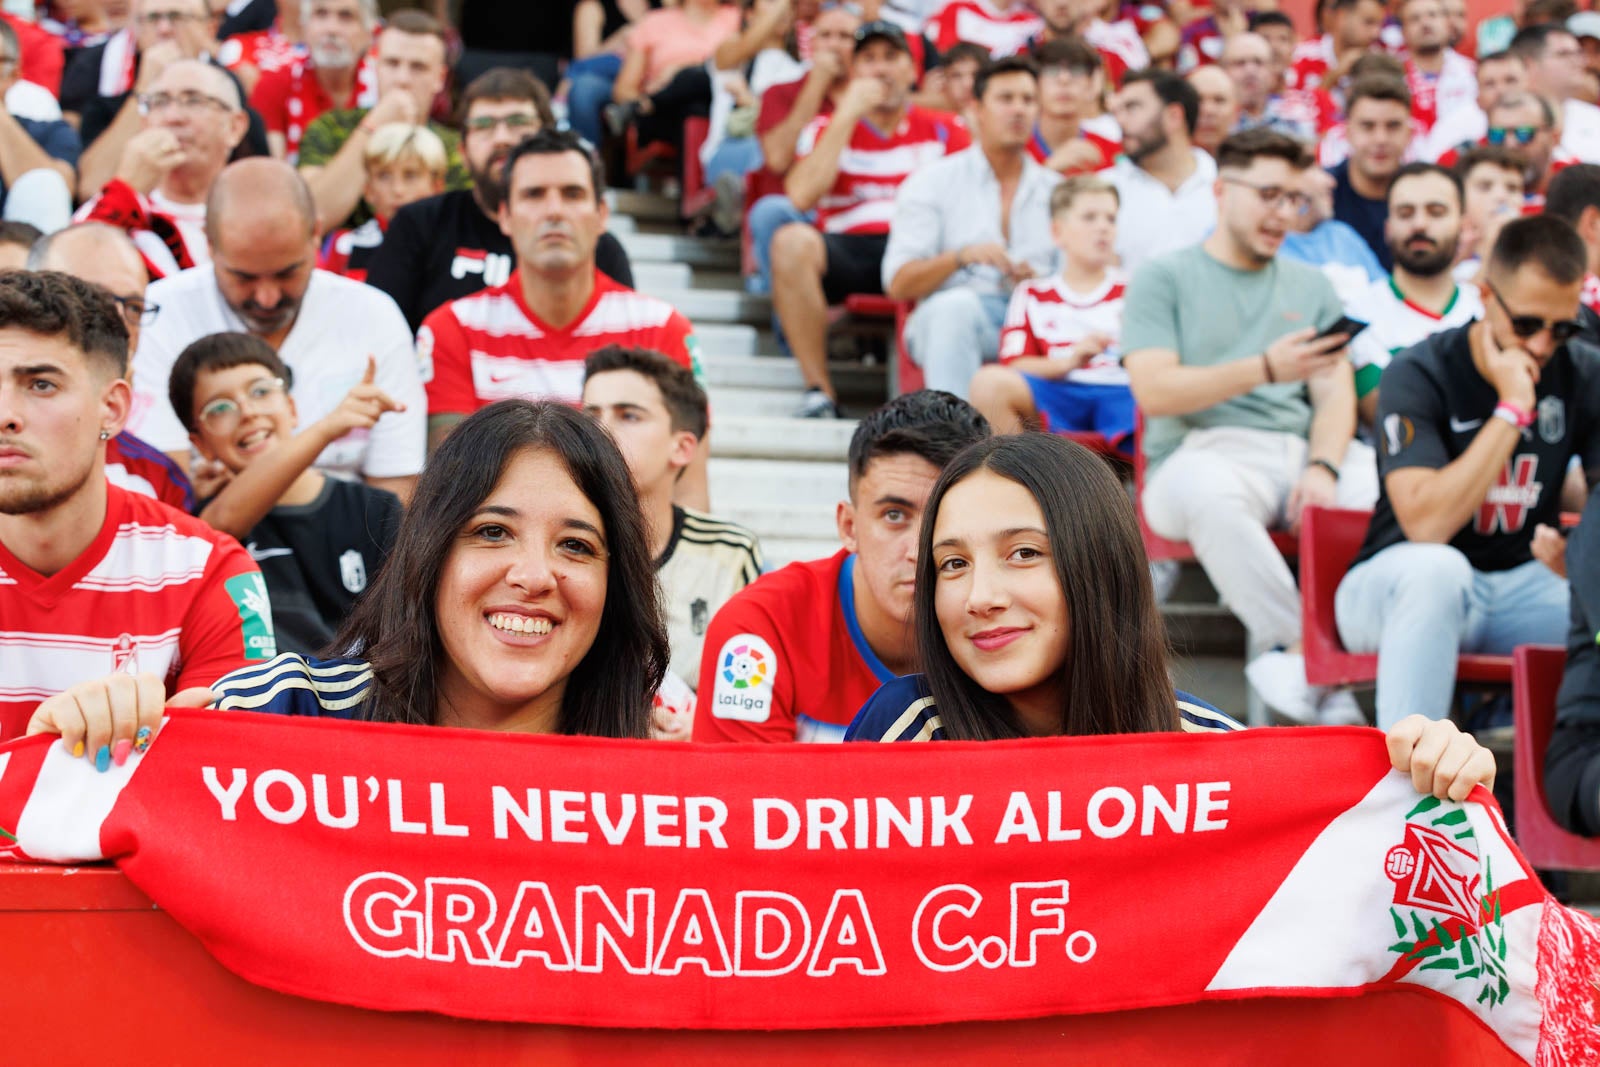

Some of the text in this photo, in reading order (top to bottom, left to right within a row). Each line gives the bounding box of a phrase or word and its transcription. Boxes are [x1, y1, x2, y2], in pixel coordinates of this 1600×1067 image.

[719, 693, 764, 710] LaLiga
[491, 785, 729, 849] NEVER
[752, 794, 974, 850] DRINK
[994, 781, 1231, 844] ALONE
[342, 871, 1097, 977] GRANADA C.F.
